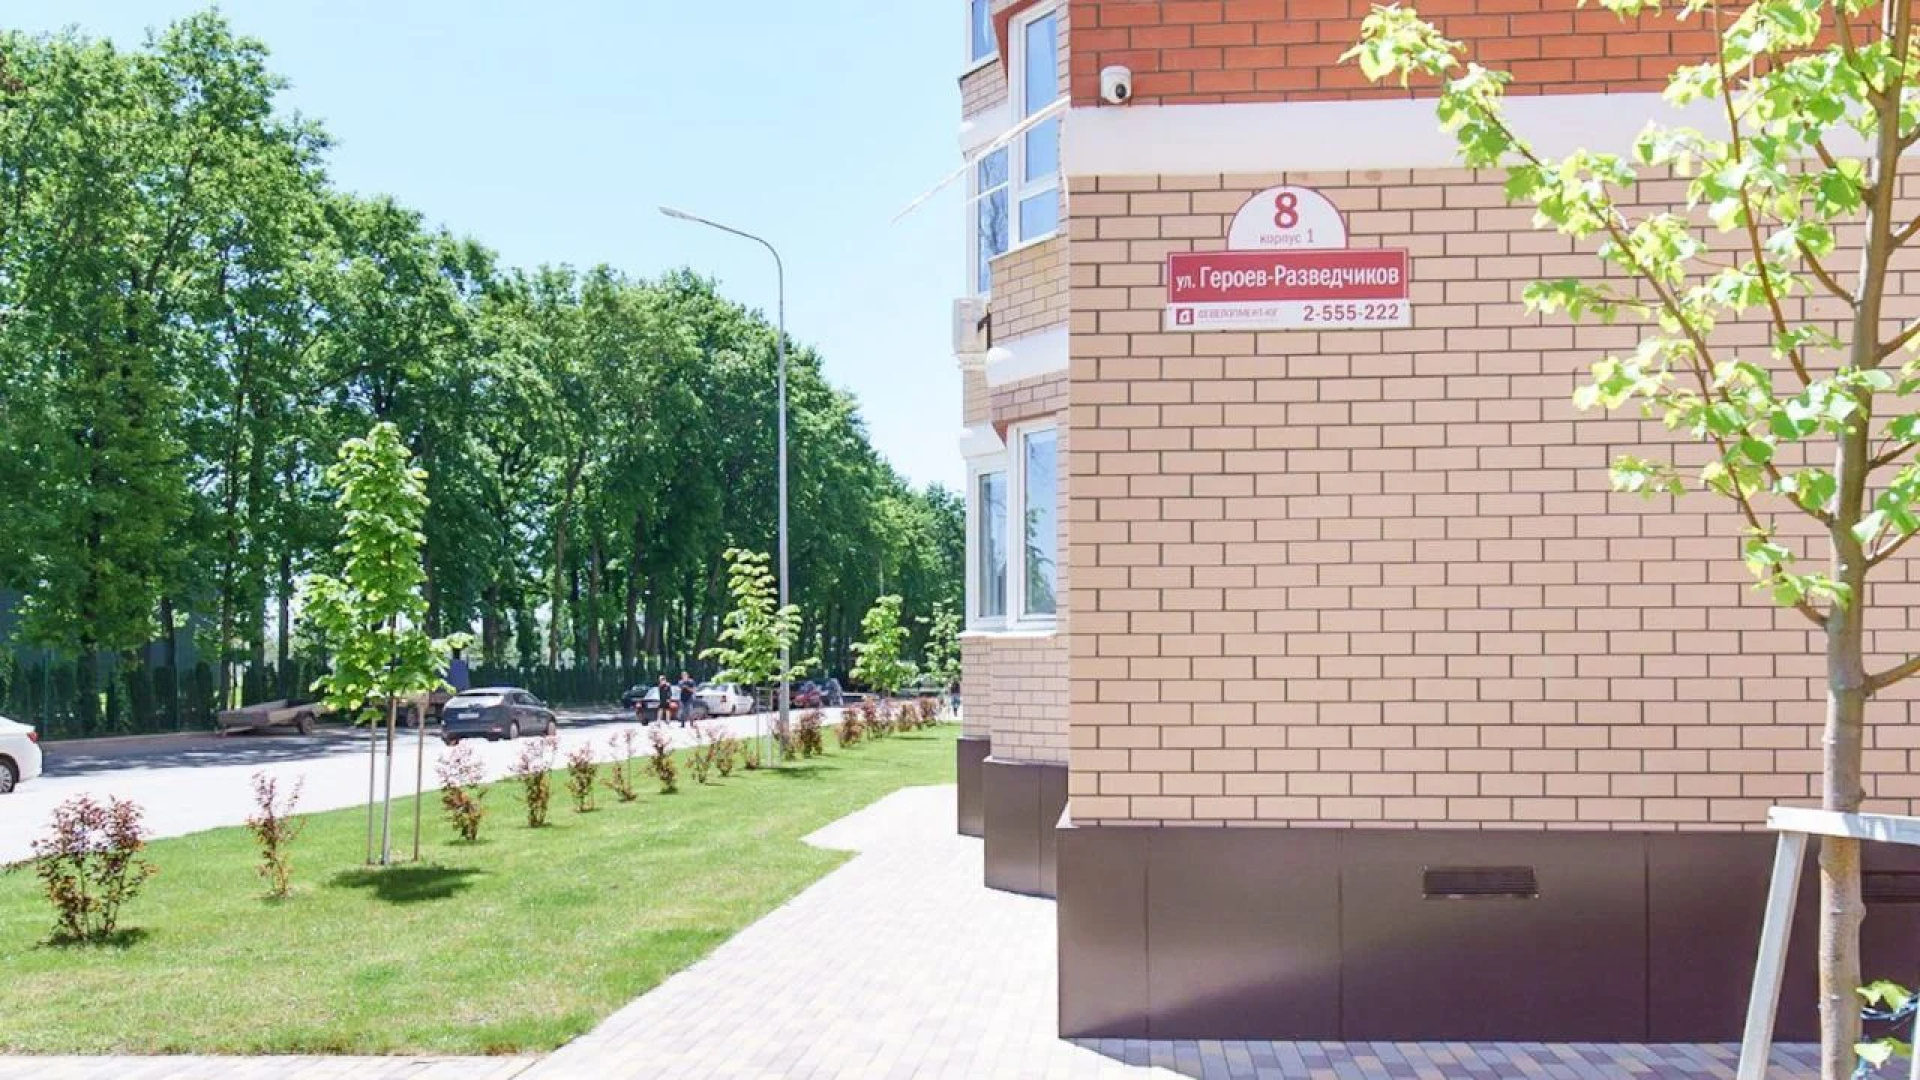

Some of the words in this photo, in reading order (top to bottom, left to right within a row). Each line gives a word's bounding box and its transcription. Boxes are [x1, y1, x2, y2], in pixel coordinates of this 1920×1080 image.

[1274, 191, 1298, 229] 8
[1260, 233, 1302, 245] корпус
[1307, 228, 1315, 243] 1
[1176, 275, 1197, 292] ул.
[1199, 264, 1400, 292] Героев-Разведчиков
[1303, 303, 1399, 321] 2-555-222
